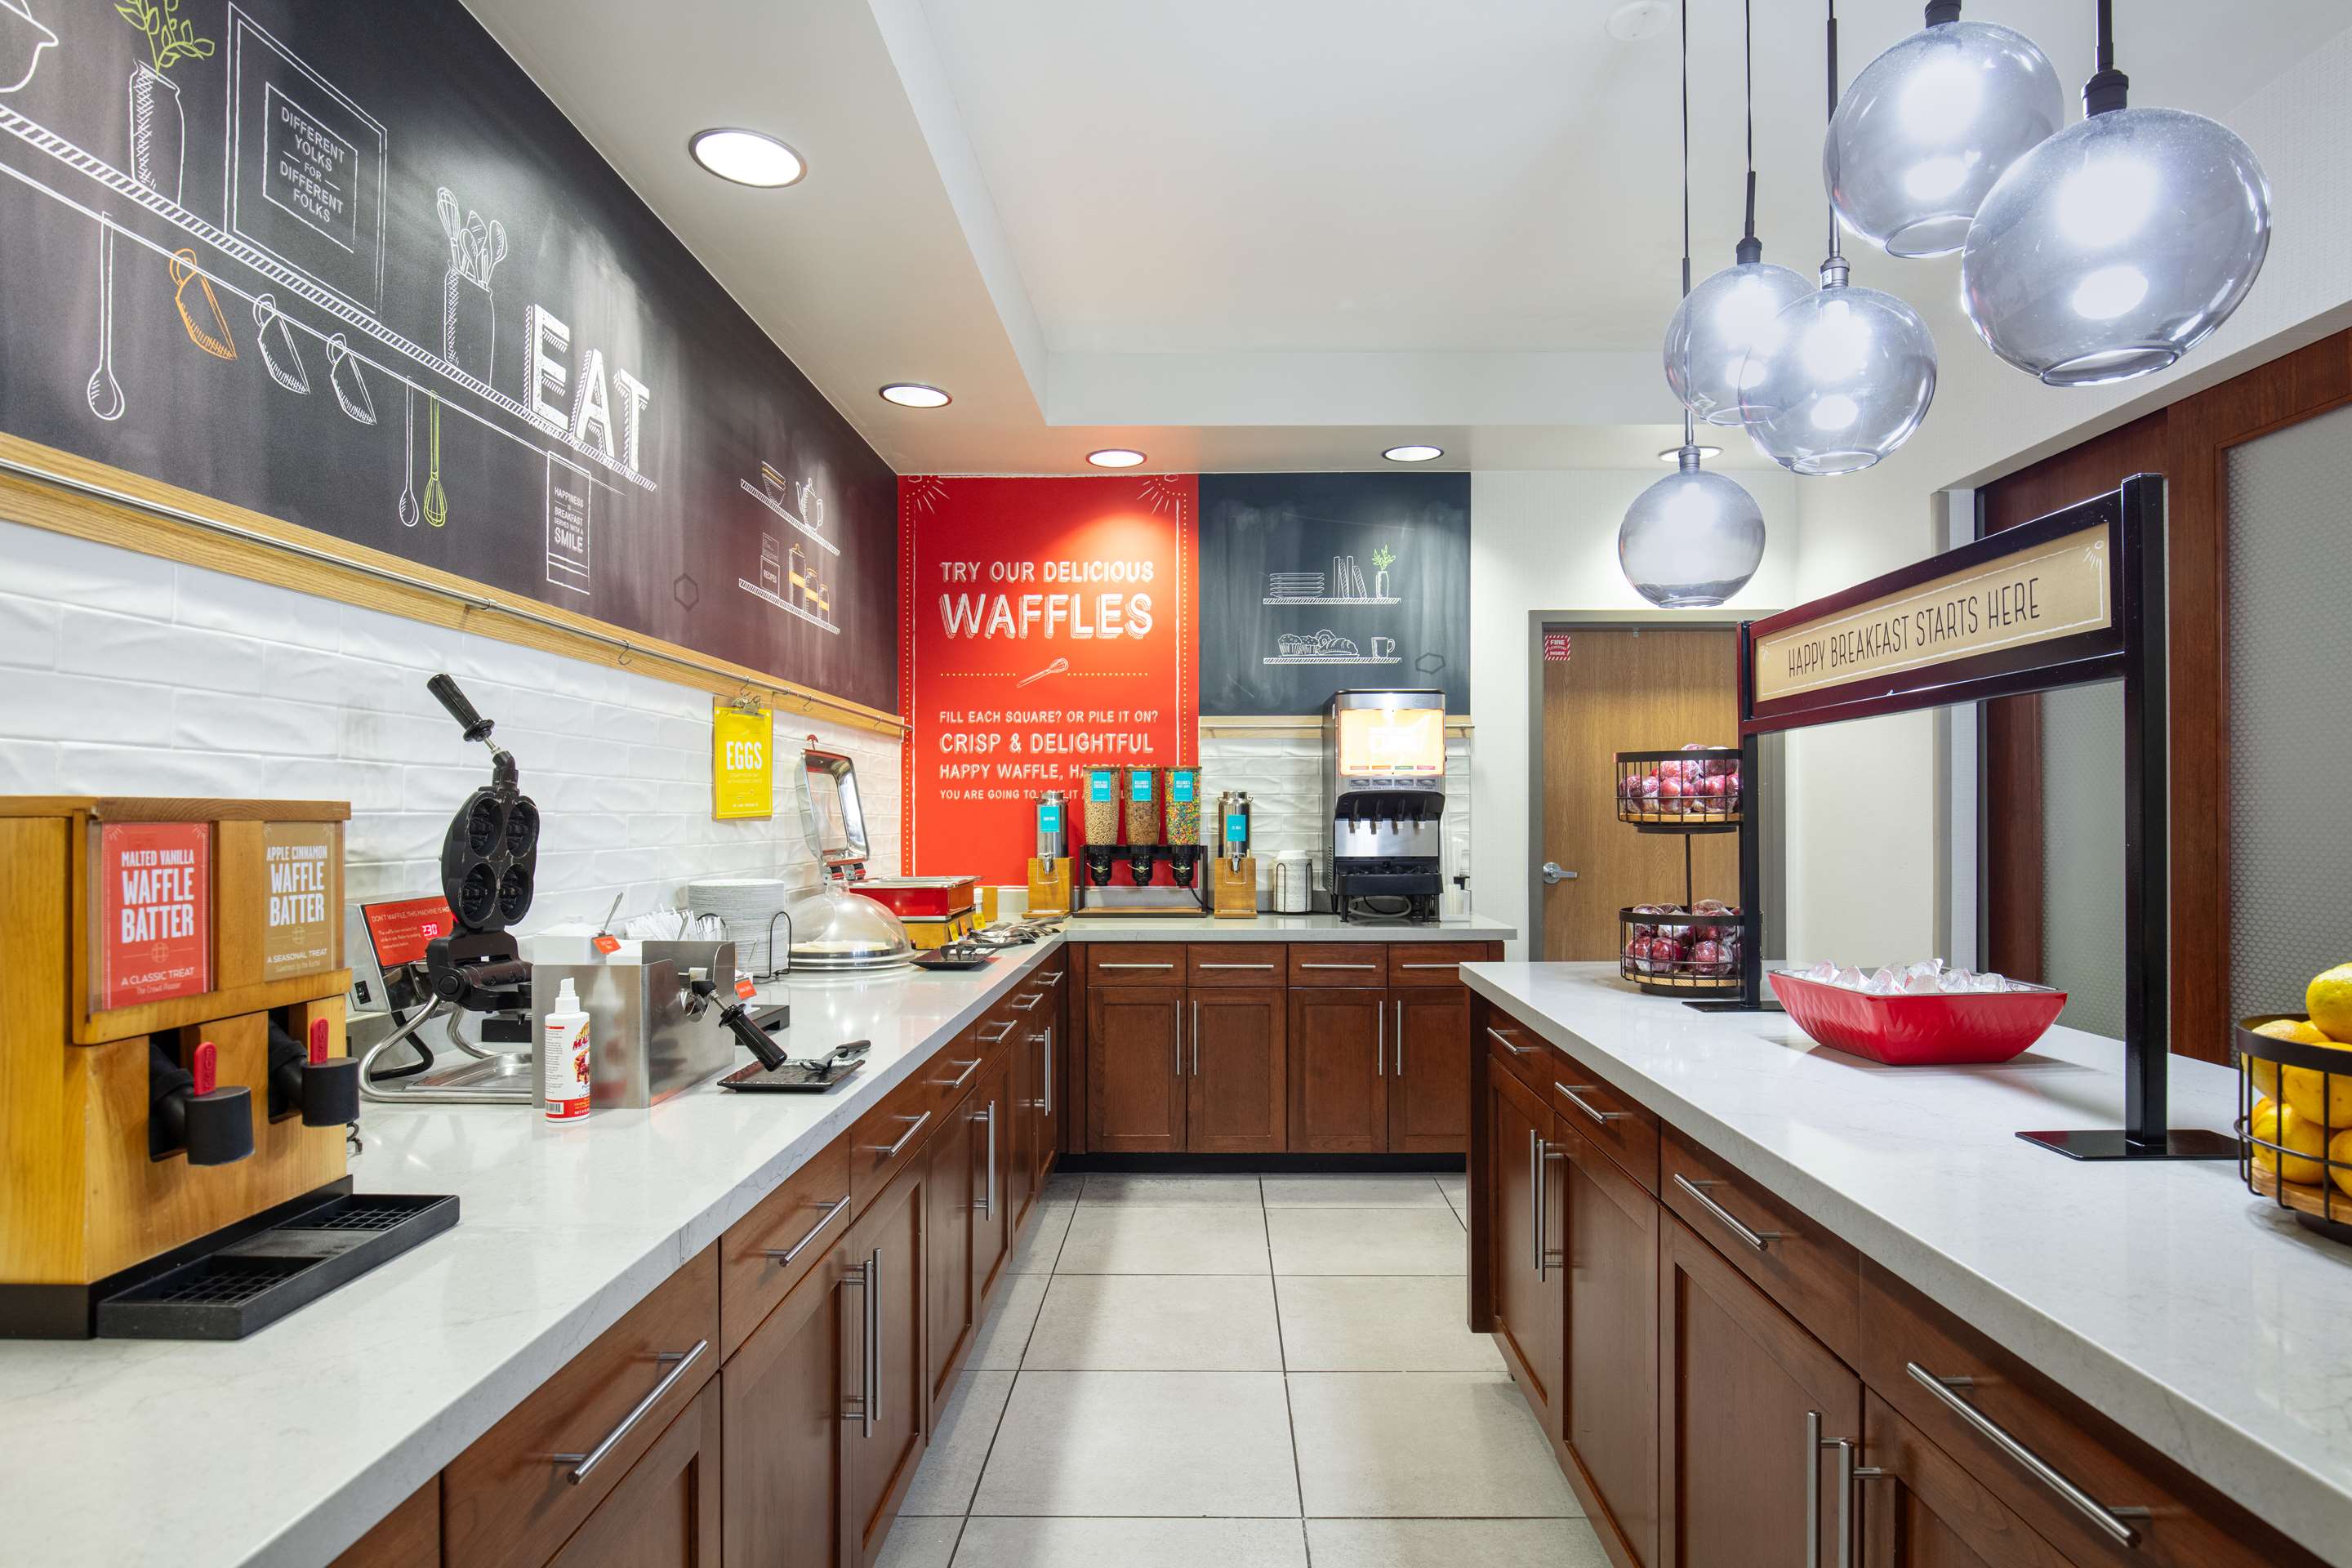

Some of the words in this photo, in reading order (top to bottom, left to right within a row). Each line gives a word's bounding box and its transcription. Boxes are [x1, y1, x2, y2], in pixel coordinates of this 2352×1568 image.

[281, 106, 345, 163] DIFFERENT
[295, 134, 332, 172] YOLKS
[304, 163, 322, 182] FOR
[279, 160, 343, 214] DIFFERENT
[293, 189, 331, 223] FOLKS
[523, 304, 650, 474] EAT
[555, 486, 584, 508] HAPPINESS
[555, 506, 583, 527] BREAKFAST
[554, 527, 584, 554] SMILE
[940, 561, 981, 583] TRY
[990, 561, 1035, 583] OUR
[1044, 560, 1154, 583] DELICIOUS
[939, 593, 1153, 639] WAFFLES
[1788, 640, 1825, 678] HAPPY
[1831, 615, 1909, 668] BREAKFAST
[1916, 596, 1978, 647] STARTS
[1988, 577, 2040, 629] HERE
[939, 710, 964, 724] FILL
[968, 710, 1000, 724] EACH
[1005, 710, 1062, 724] SQUARE?
[1067, 710, 1085, 723] OR
[1088, 710, 1115, 723] PILE
[1118, 710, 1129, 723] IT
[1134, 710, 1158, 723] ON?
[726, 741, 763, 770] EGGS
[939, 733, 1000, 754] CRISP
[1009, 733, 1022, 753] &
[1030, 733, 1154, 754] DELIGHTFUL
[939, 764, 991, 780] HAPPY
[996, 764, 1063, 781] WAFFLE,
[940, 789, 960, 800] YOU
[964, 789, 984, 800] ARE
[987, 789, 1019, 800] GOING
[1023, 789, 1036, 800] TO
[121, 850, 157, 867] MALTED
[159, 849, 194, 865] VANILLA
[266, 846, 290, 862] APPLE
[292, 844, 327, 860] CINNAMON
[122, 867, 194, 906] WAFFLE
[270, 862, 325, 894] WAFFLE
[270, 893, 324, 927] BATTER
[372, 914, 387, 923] DON'T
[417, 908, 438, 916] MACHINE
[121, 903, 194, 944] BATTER
[267, 956, 273, 964] A
[273, 951, 307, 964] SEASONAL
[309, 947, 327, 957] TREAT
[121, 977, 128, 987] A
[130, 969, 167, 985] CLASSIC
[167, 966, 195, 978] TREAT
